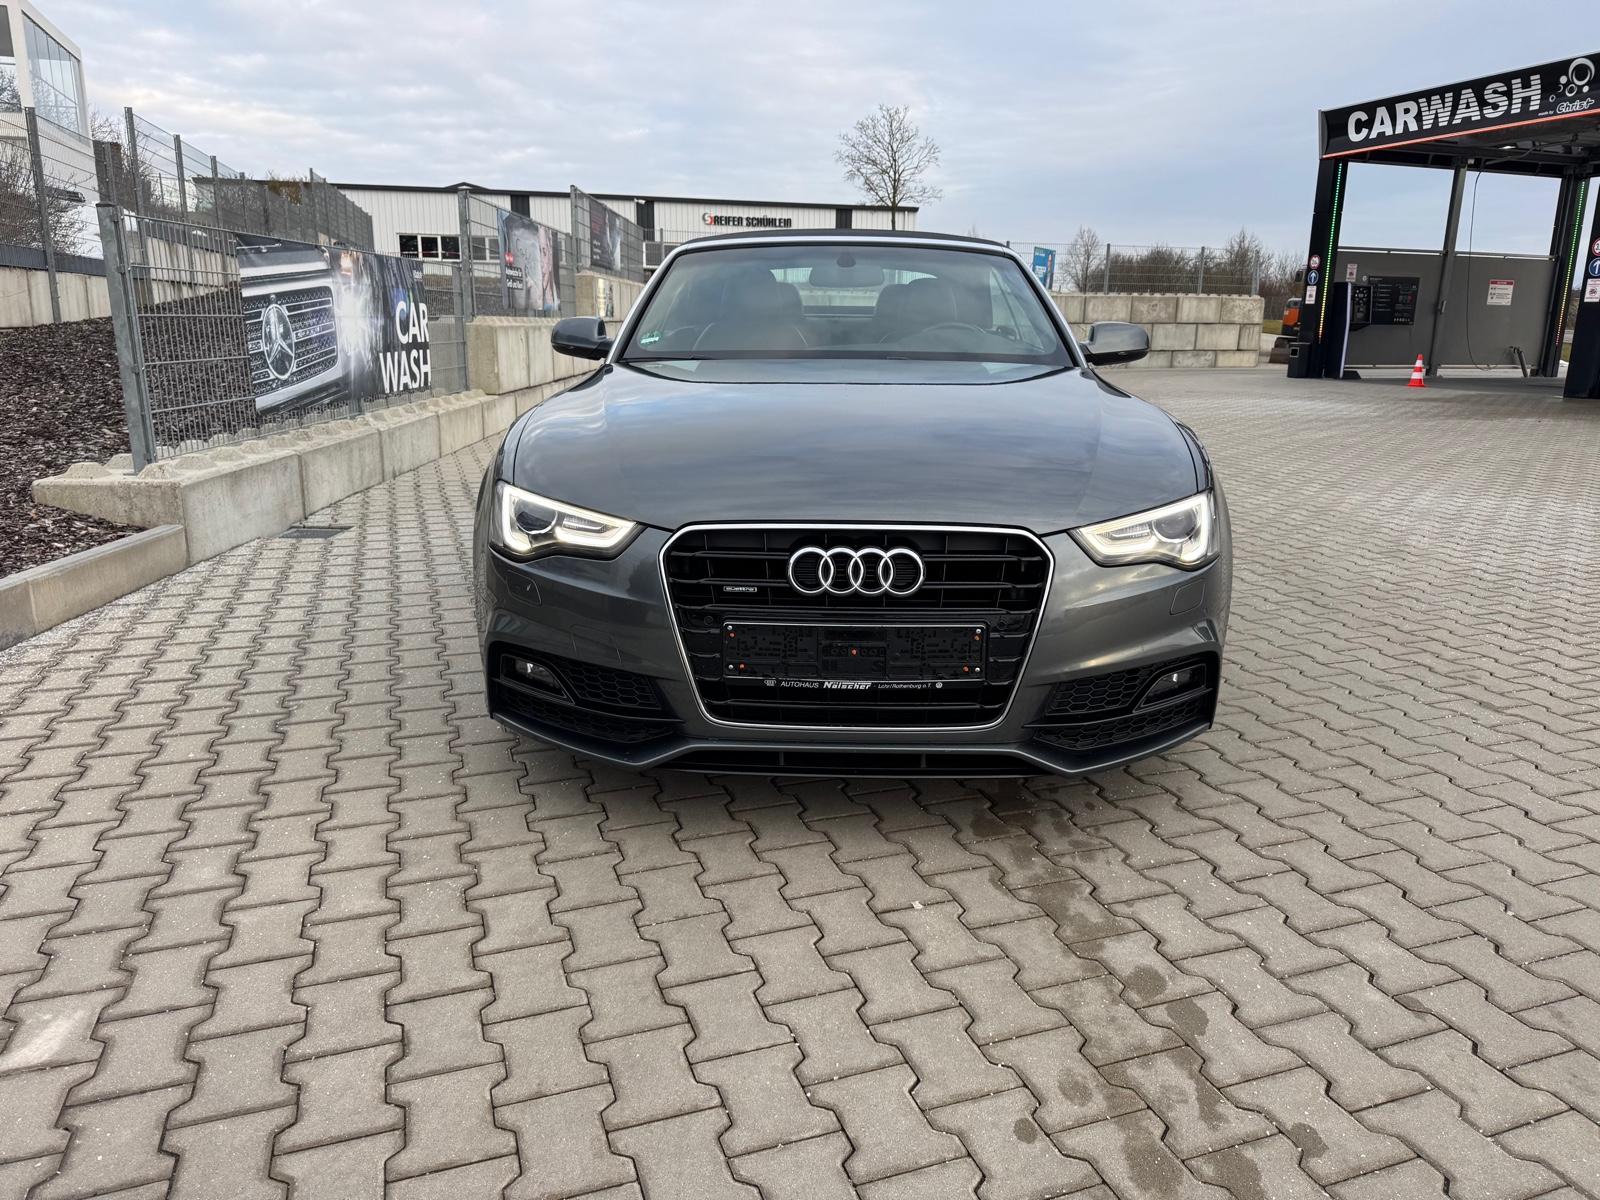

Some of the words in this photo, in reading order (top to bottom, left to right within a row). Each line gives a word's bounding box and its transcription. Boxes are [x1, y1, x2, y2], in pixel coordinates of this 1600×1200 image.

[1347, 74, 1541, 142] CARWASH
[1556, 97, 1595, 114] Christ
[713, 215, 743, 226] REIFEN
[745, 214, 792, 228] SCHÜHLEIN
[395, 300, 430, 345] CAR
[379, 348, 431, 394] WASH
